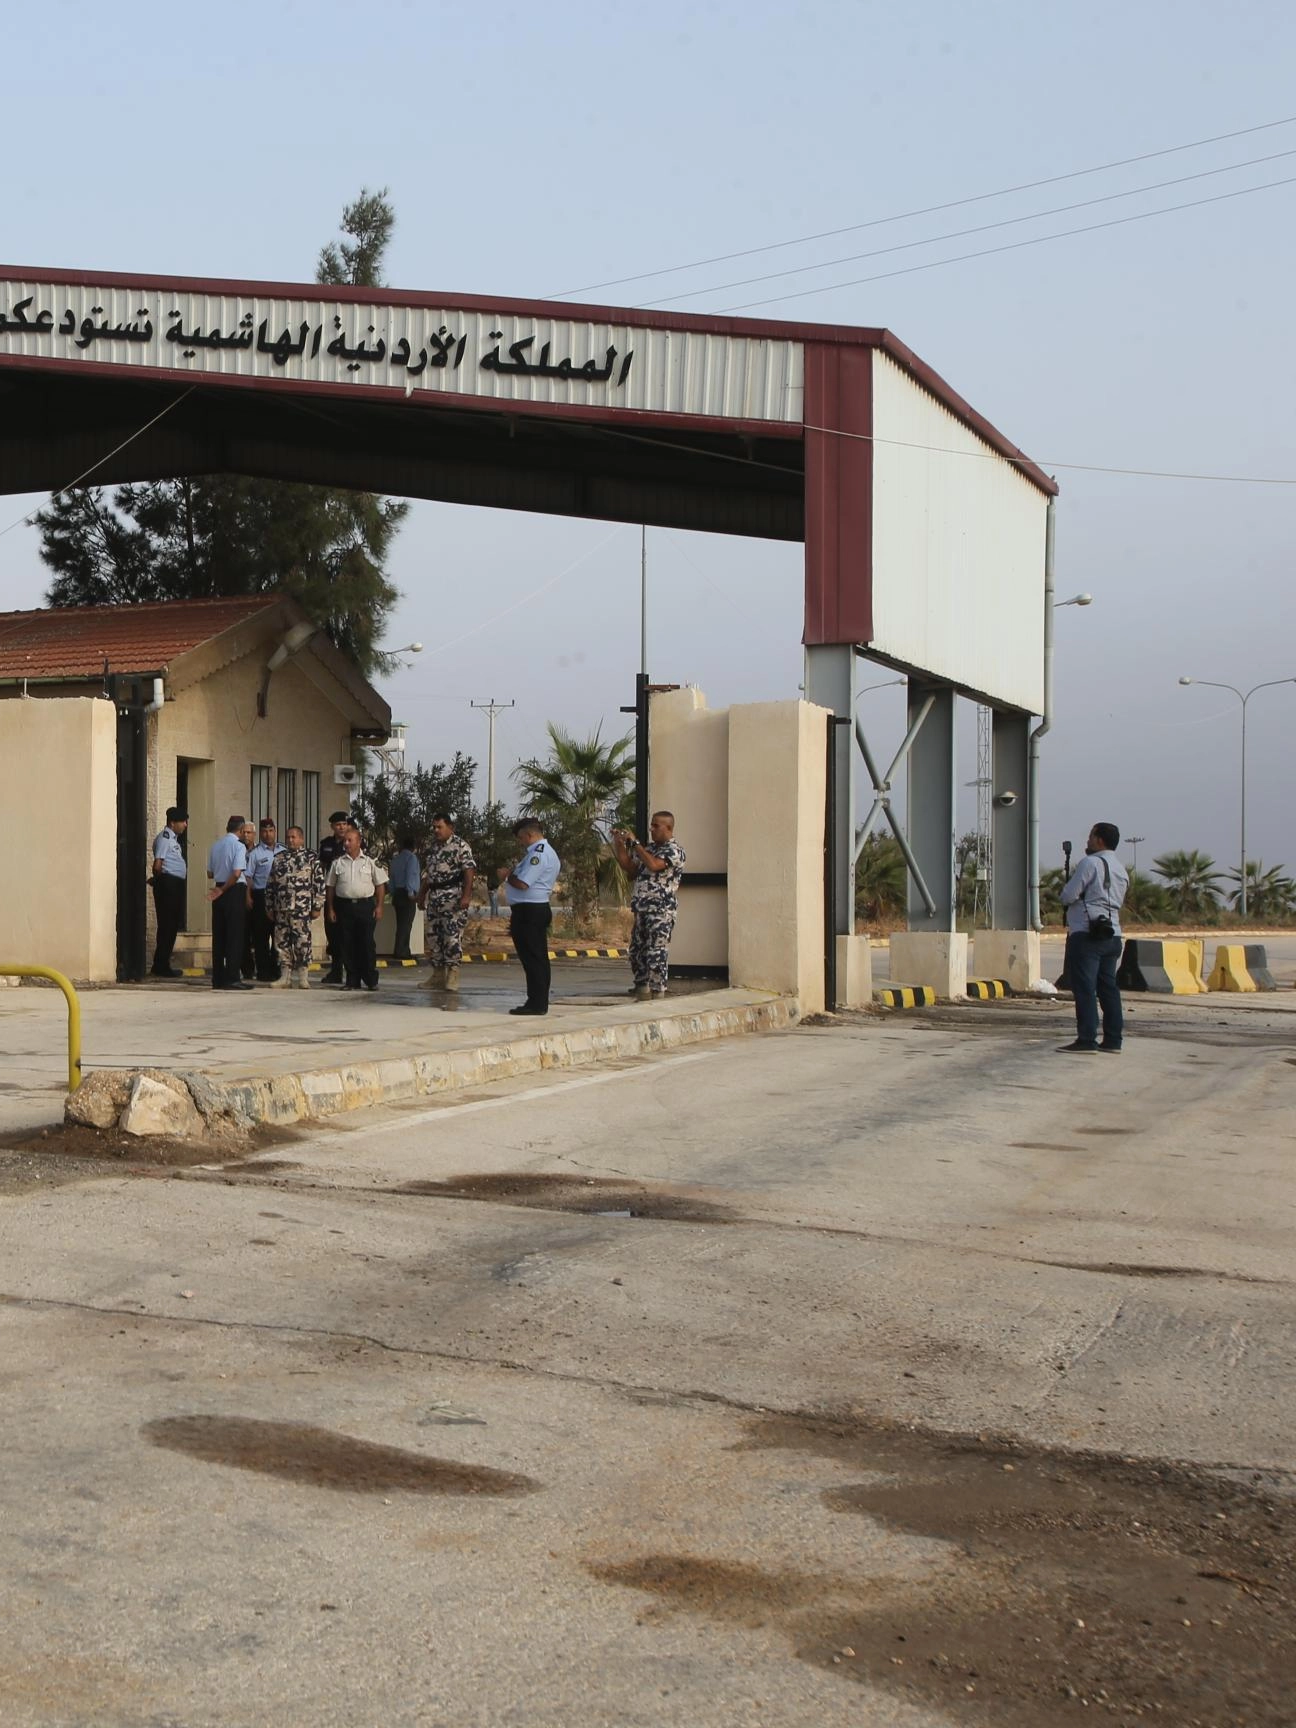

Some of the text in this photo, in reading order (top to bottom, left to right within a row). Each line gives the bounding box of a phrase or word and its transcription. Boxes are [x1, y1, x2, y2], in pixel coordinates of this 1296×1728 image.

[165, 312, 323, 367] الهاشمية
[326, 314, 468, 376] الأردنية
[479, 330, 635, 388] المملكة
